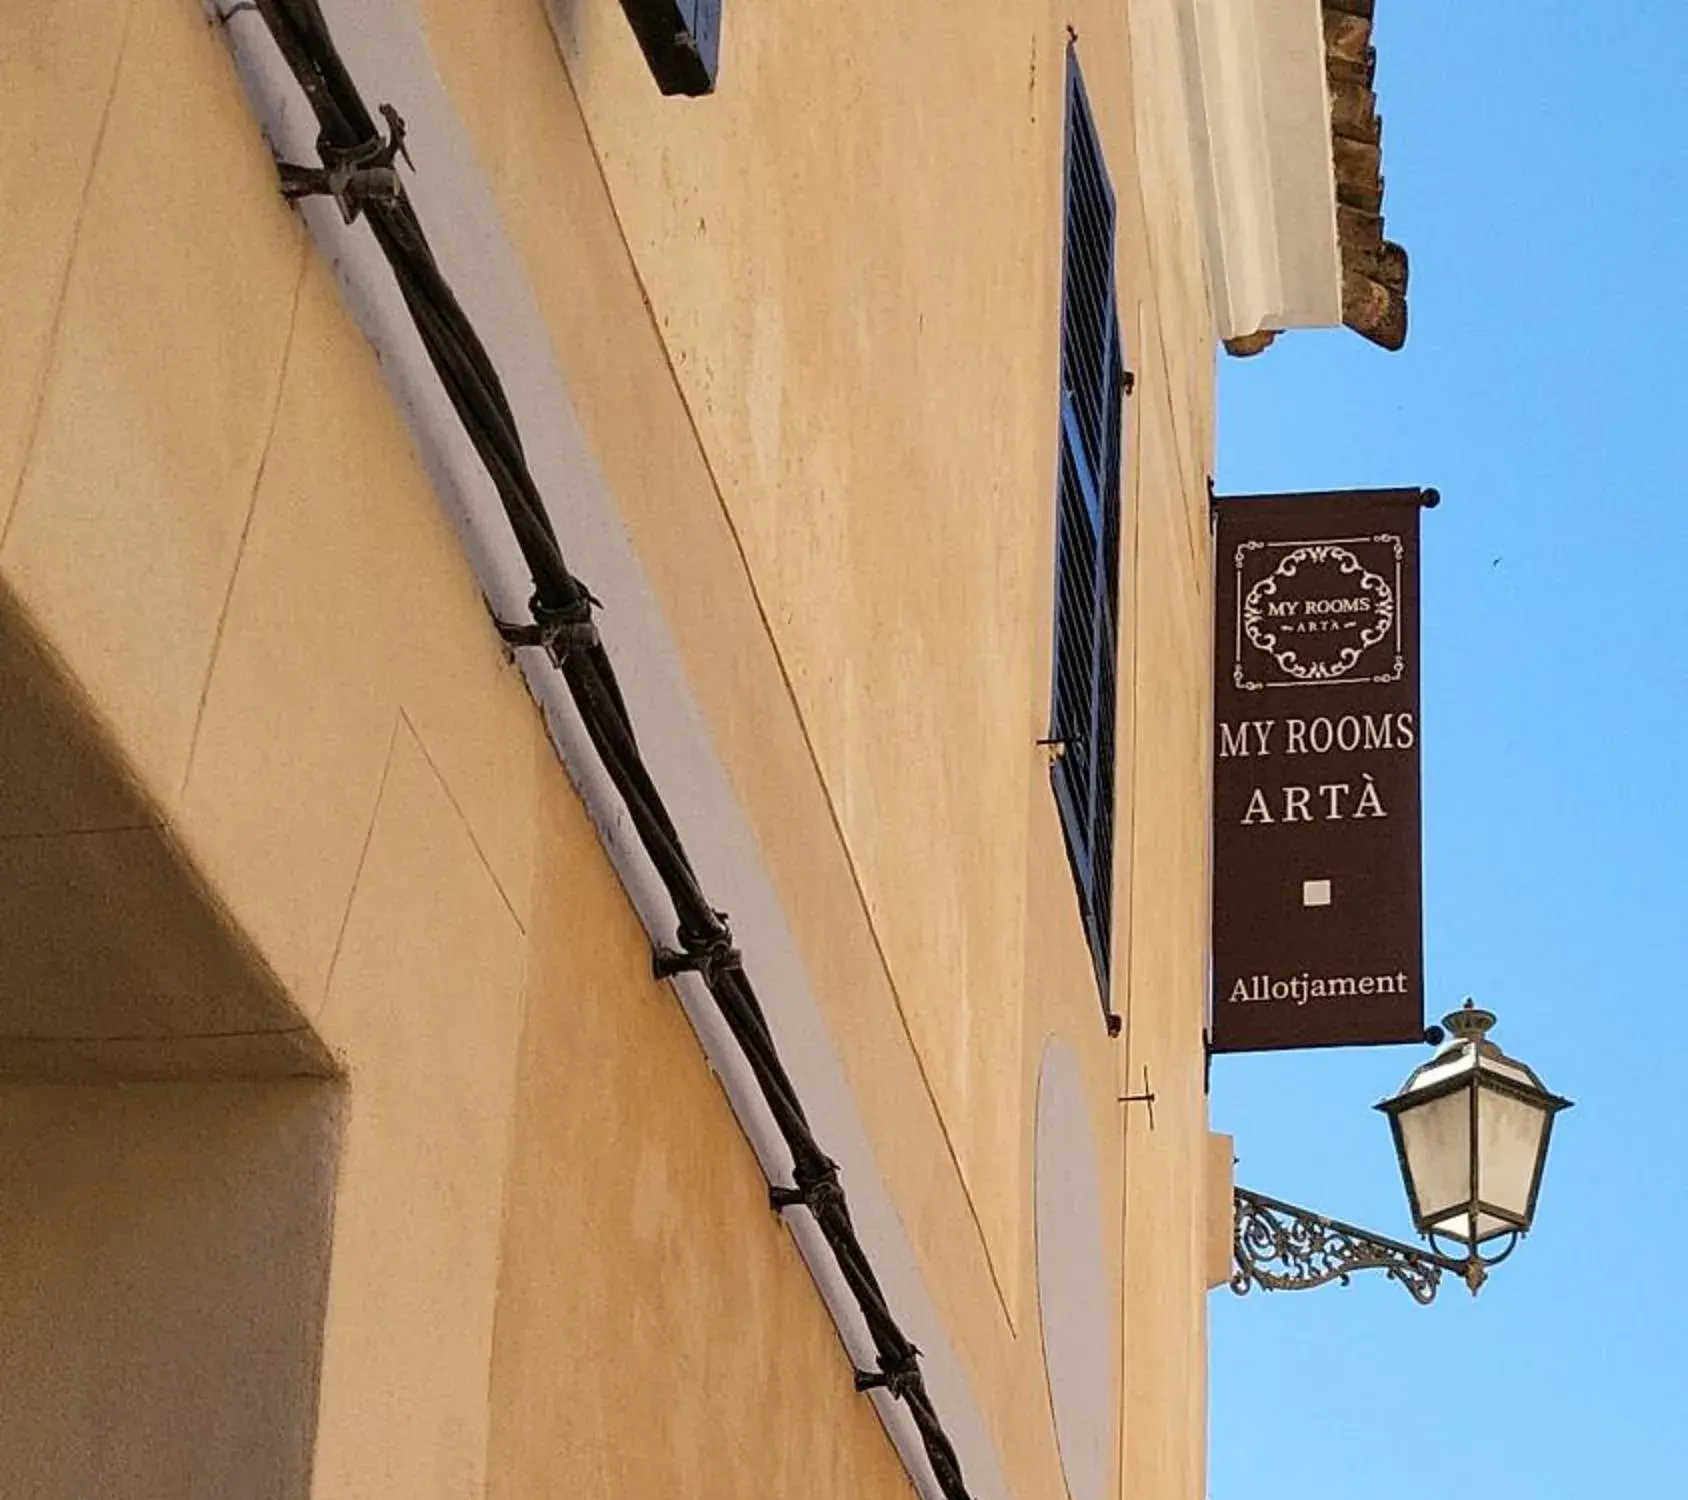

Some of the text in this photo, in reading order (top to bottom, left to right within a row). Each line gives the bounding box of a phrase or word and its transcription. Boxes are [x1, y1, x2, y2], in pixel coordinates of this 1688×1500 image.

[1267, 597, 1371, 617] MY ROOMS
[1219, 713, 1414, 757] MY ROOMS
[1240, 773, 1388, 825] ARTÀ
[1229, 972, 1408, 1005] Allotjament
